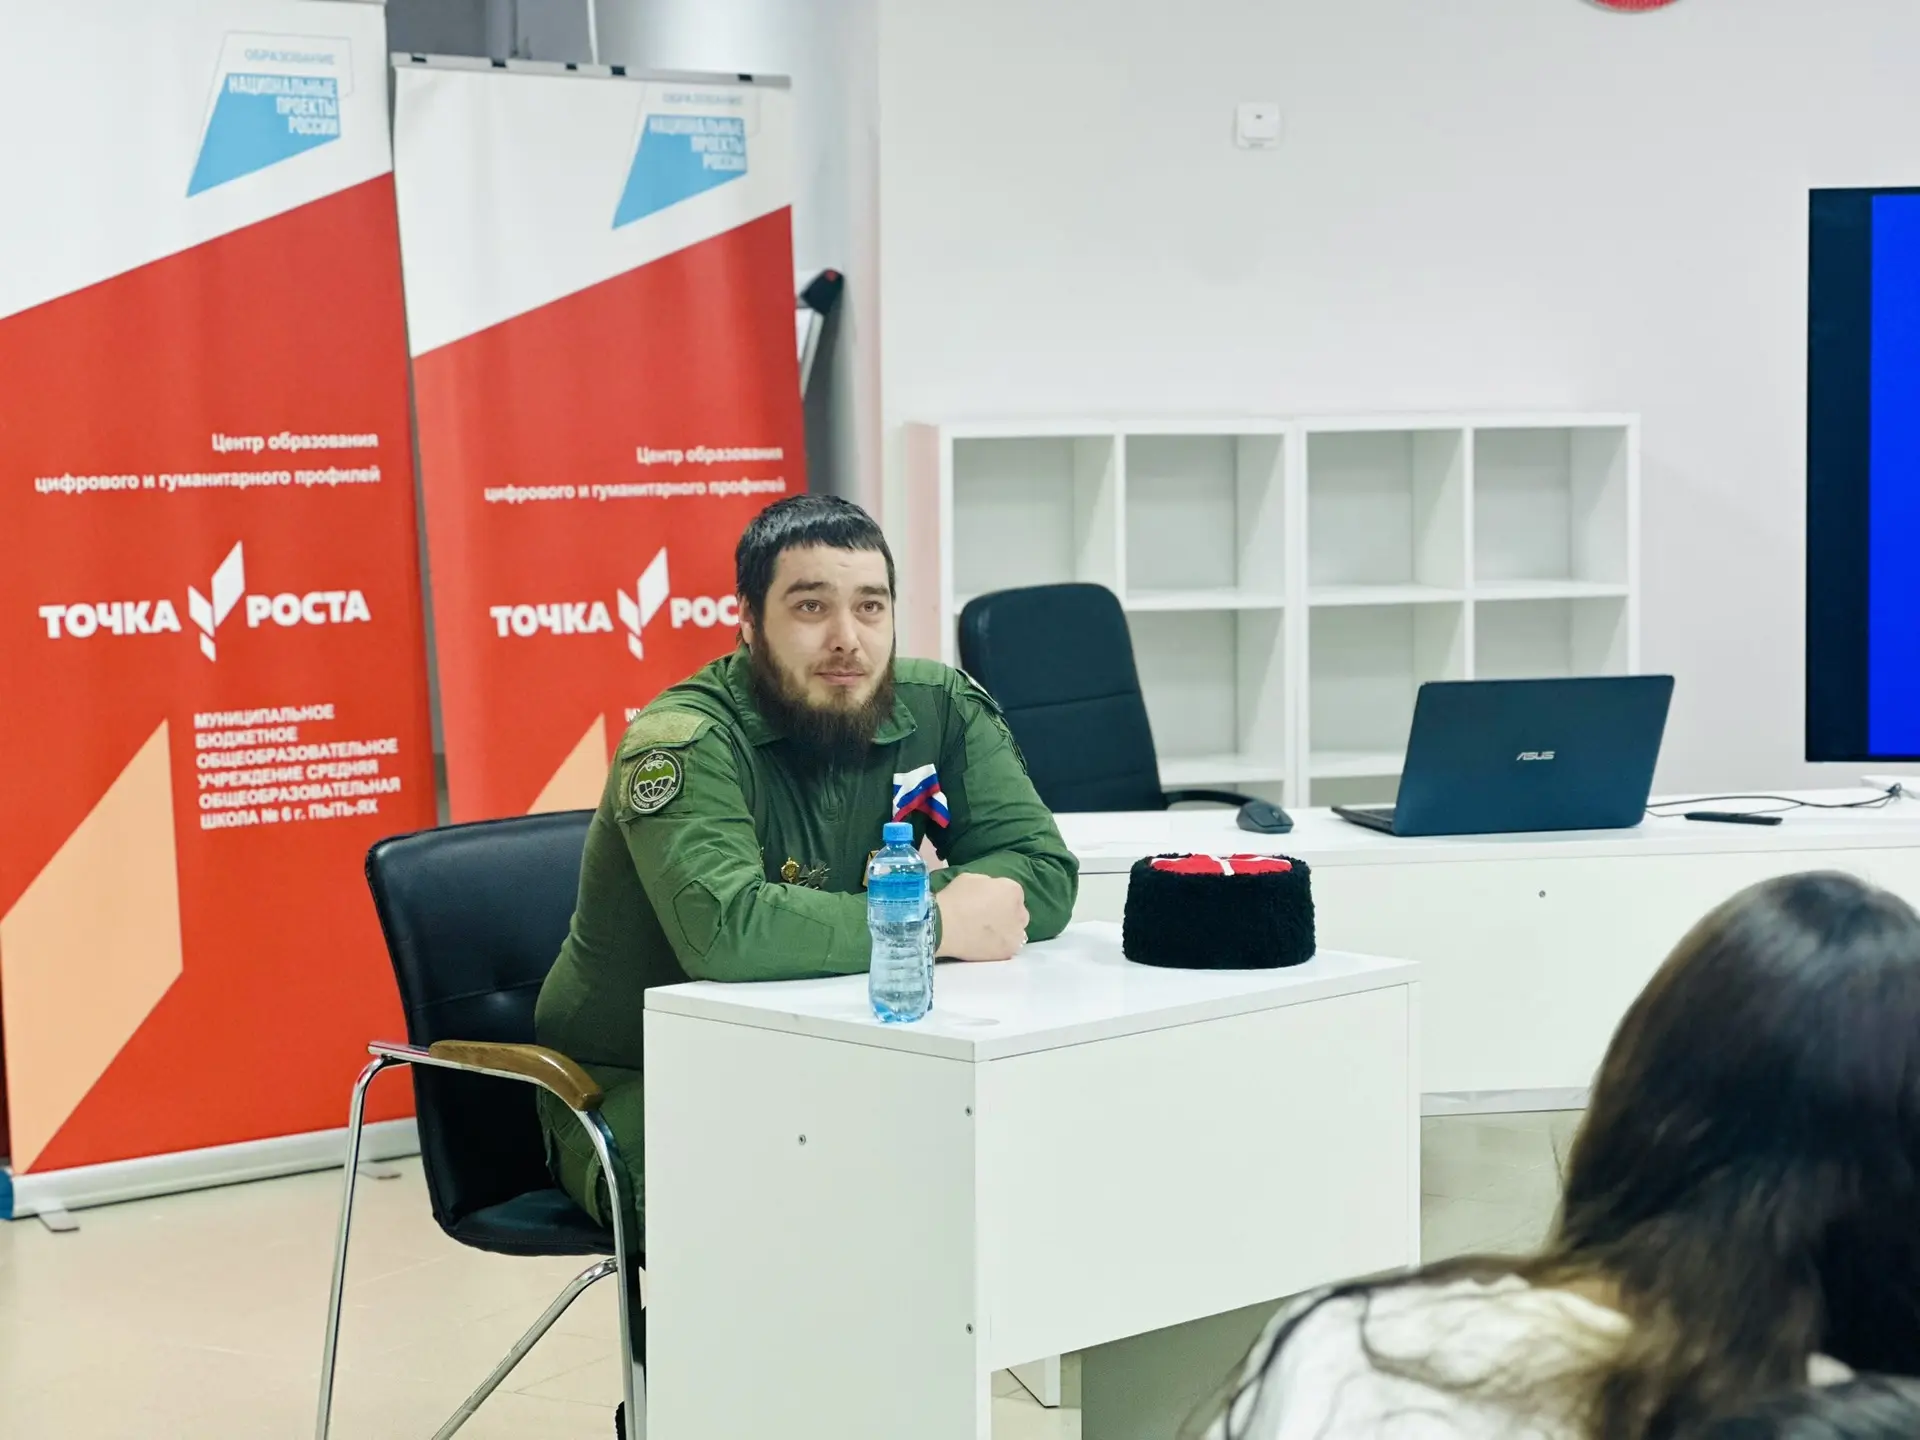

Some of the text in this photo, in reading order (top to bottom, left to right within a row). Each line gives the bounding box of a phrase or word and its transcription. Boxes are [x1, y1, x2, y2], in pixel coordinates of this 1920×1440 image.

[228, 75, 338, 98] НАЦИОНАЛЬНЫЕ
[275, 96, 338, 117] ПРОЕКТЫ
[288, 116, 339, 135] РОССИИ
[649, 116, 744, 137] НАЦИОНАЛЬНЫЕ
[690, 135, 746, 154] ПРОЕКТЫ
[211, 431, 379, 454] Центр образования
[636, 445, 784, 467] Центр образования
[34, 465, 382, 494] цифрового и гуманитарного профилей
[484, 476, 786, 504] цифрового и гуманитарного профилей
[38, 589, 372, 639] ТОЧКА РОСТА
[489, 594, 740, 638] ТОЧКА РОС
[193, 703, 335, 729] МУНИЦИПАЛЬНОЕ
[195, 726, 298, 750] БЮДЖЕТНОЕ
[196, 737, 399, 769] ОБЩЕОБРАЗОВАТЕЛЬНОЕ
[1515, 750, 1556, 761] ASUS
[197, 759, 379, 790] УЧРЕЖДЕНИЕ СРЕДНЯЯ
[198, 777, 401, 809] ОБЩЕОБРАЗОВАТЕЛЬНАЯ
[200, 809, 259, 830] ШКОЛА
[261, 808, 279, 823] №
[294, 809, 306, 821] г.
[308, 798, 379, 820] ПЫТЬ-ЯХ
